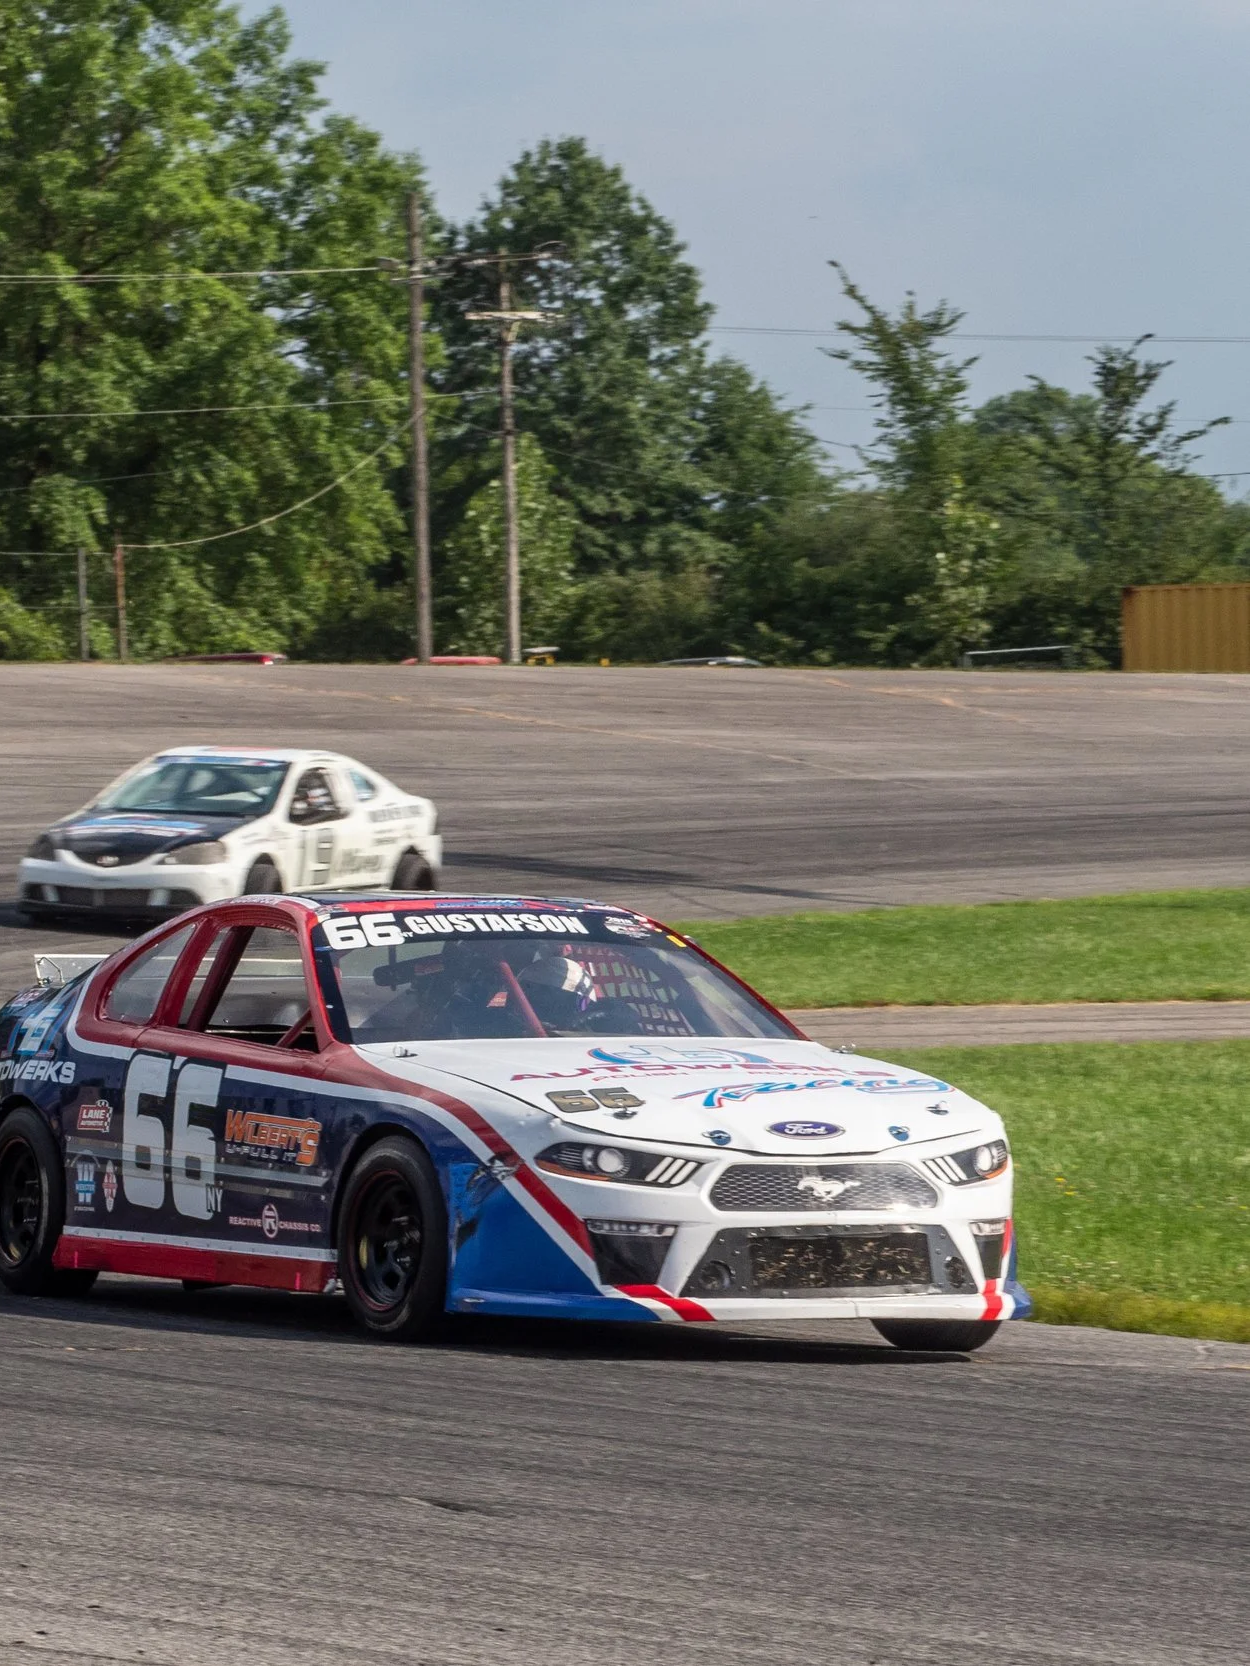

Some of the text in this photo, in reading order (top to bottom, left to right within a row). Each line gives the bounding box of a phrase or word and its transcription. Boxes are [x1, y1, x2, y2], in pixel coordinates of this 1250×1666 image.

[321, 912, 407, 951] 66
[403, 914, 590, 935] GUSTAFSON
[510, 1063, 897, 1081] AUTOWERKS
[544, 1086, 646, 1114] 66
[81, 1108, 107, 1119] LANE
[122, 1053, 224, 1221] 66
[783, 1122, 832, 1136] Ford
[205, 1183, 223, 1213] NY
[228, 1216, 263, 1227] REACTIVE
[278, 1220, 309, 1231] CHASSIS
